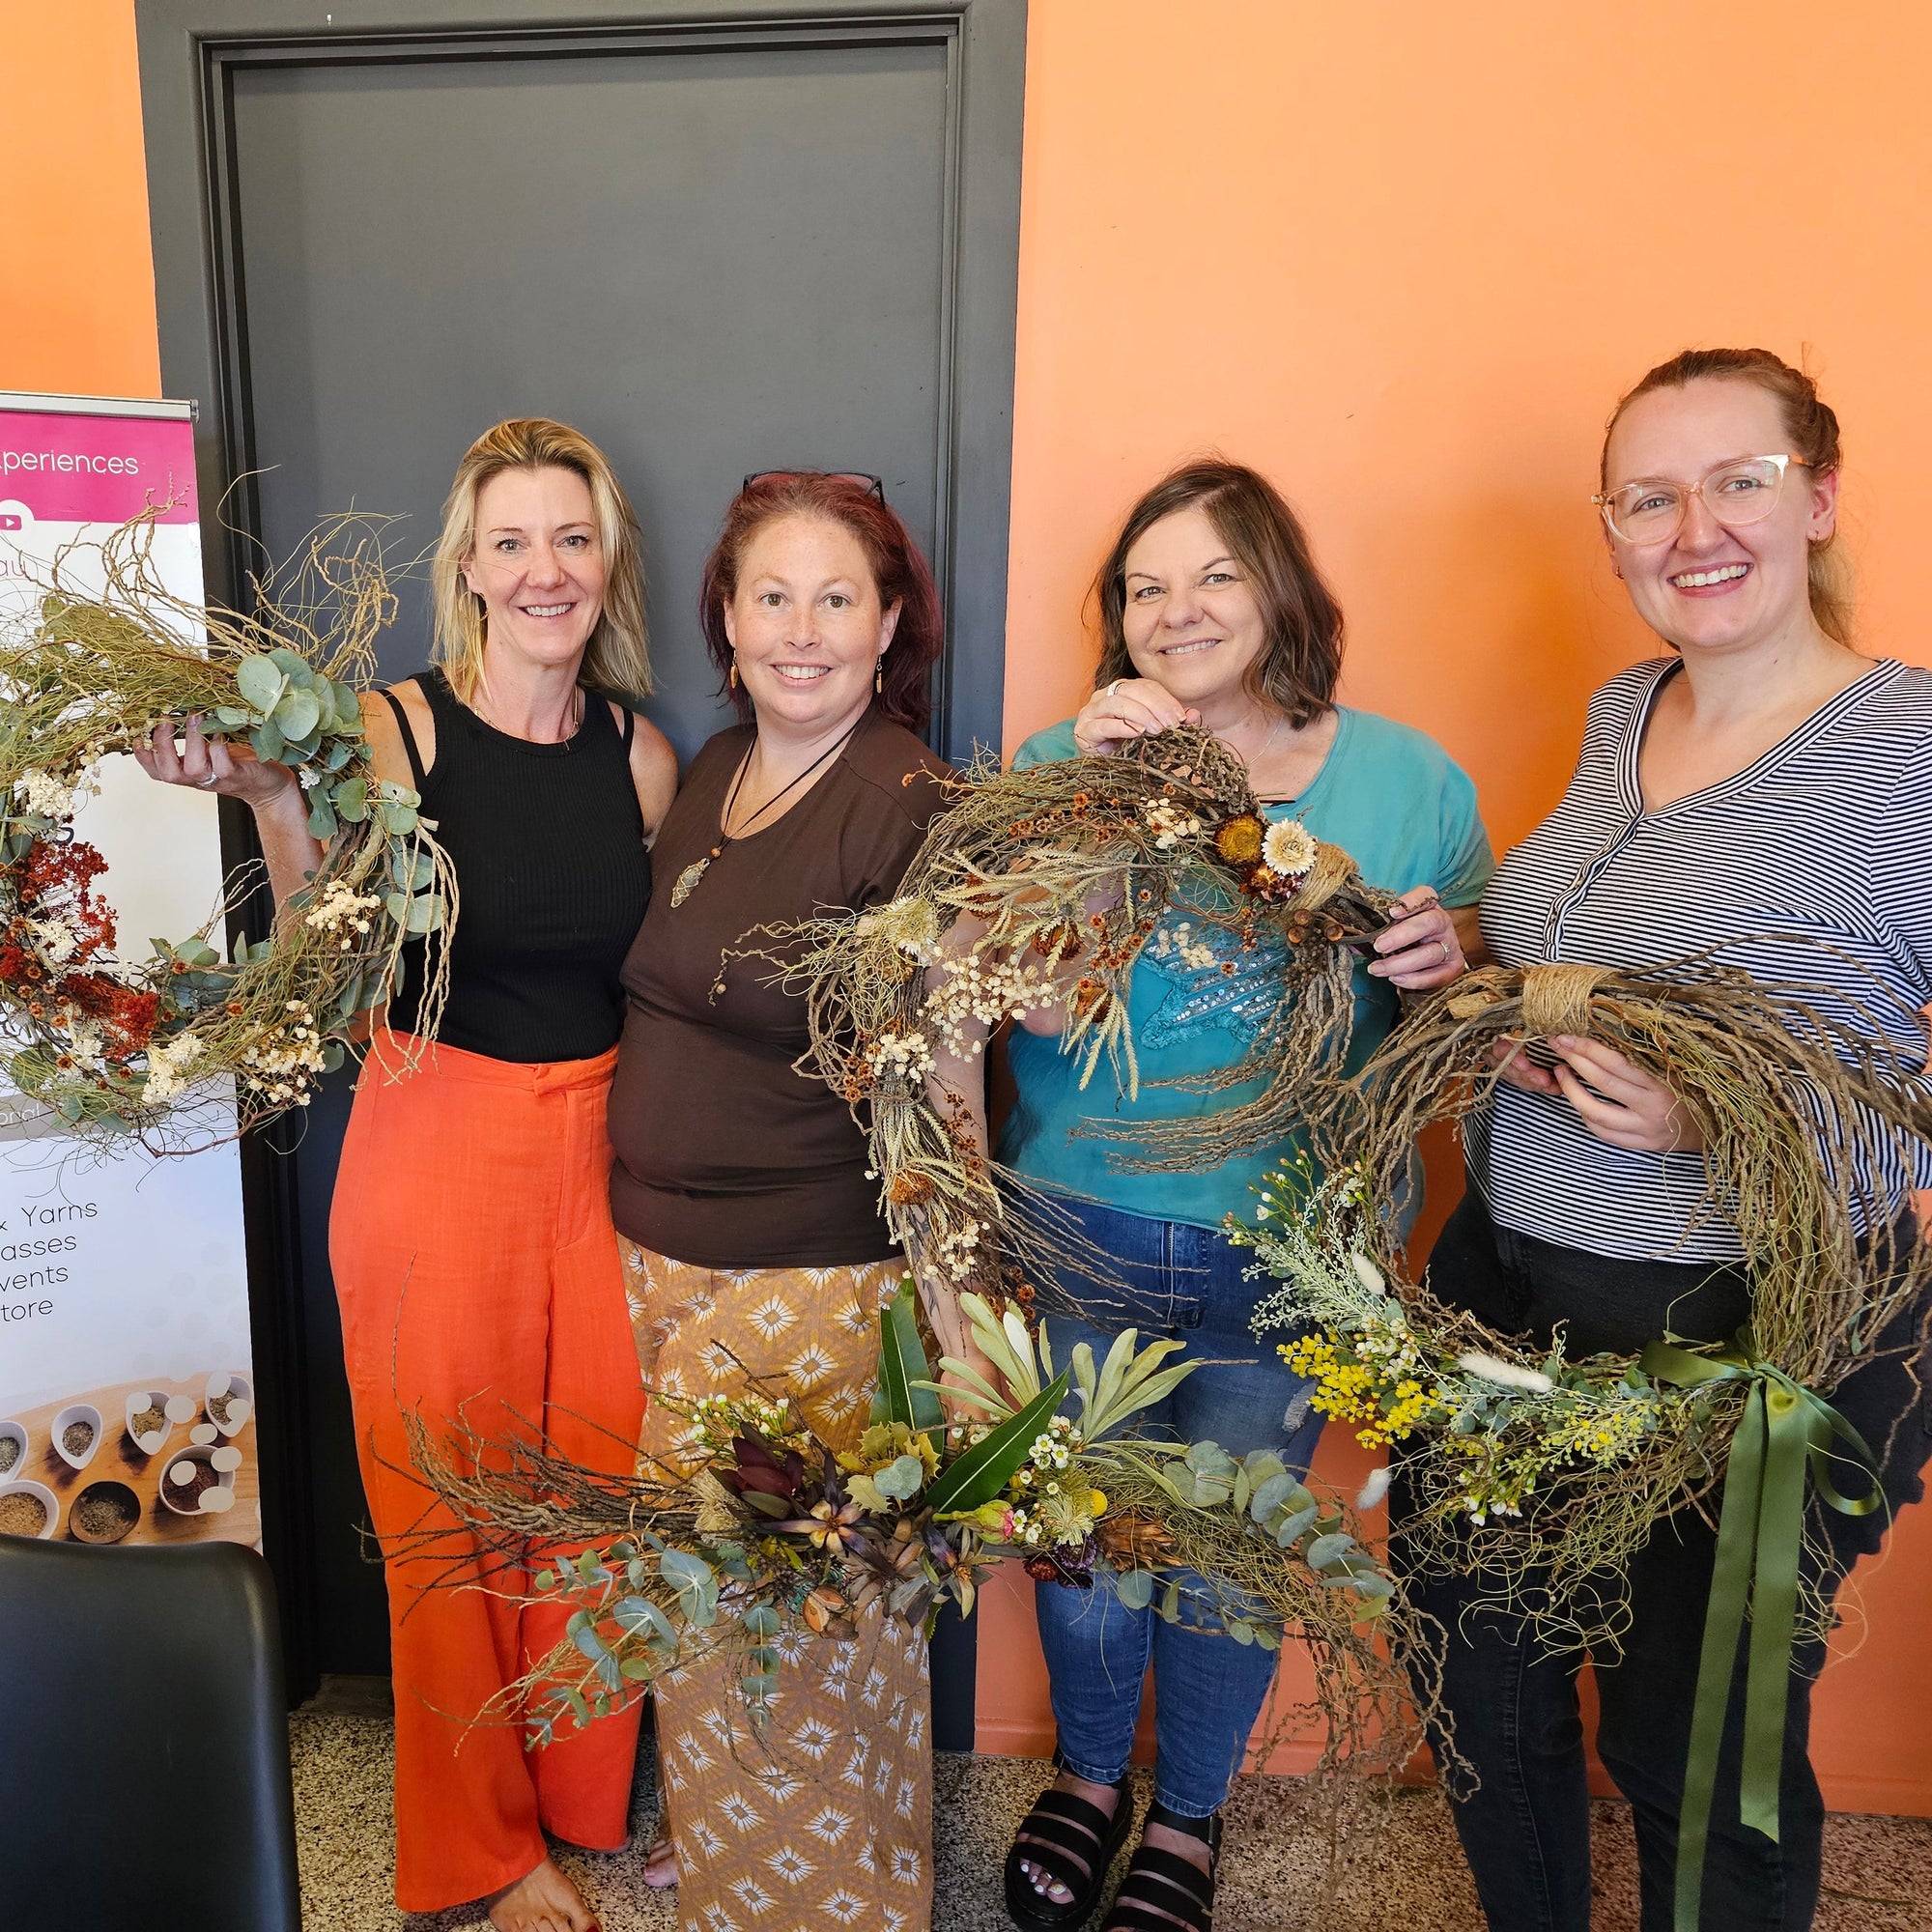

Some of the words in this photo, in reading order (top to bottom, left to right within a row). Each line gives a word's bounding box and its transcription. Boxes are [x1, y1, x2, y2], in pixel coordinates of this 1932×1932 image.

[0, 449, 139, 475] periences
[21, 1203, 98, 1227] Yarns
[1, 1236, 76, 1261] asses
[0, 1266, 69, 1292] vents
[0, 1300, 53, 1322] tore
